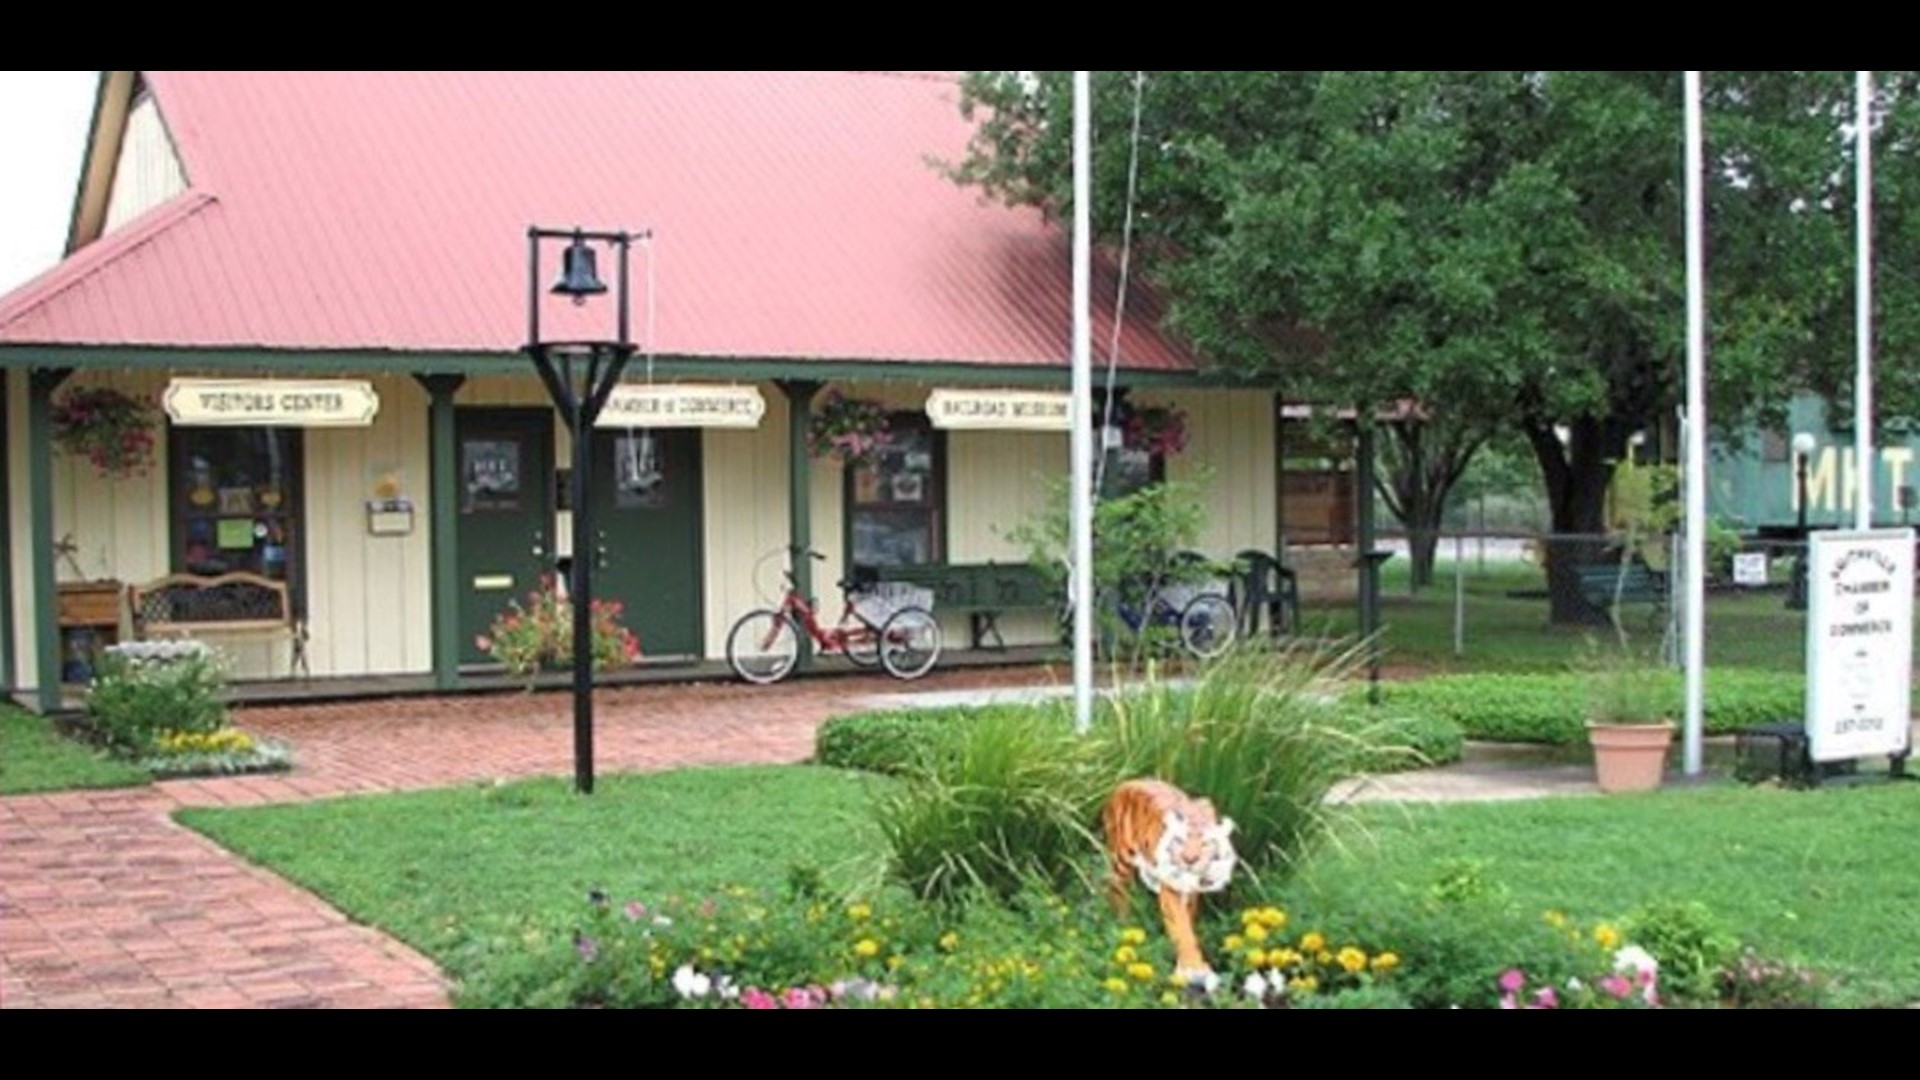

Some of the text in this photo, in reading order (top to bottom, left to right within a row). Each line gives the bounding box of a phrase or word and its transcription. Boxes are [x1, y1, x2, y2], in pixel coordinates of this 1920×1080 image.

[199, 392, 344, 412] VISITORS CENTER
[1011, 401, 1068, 417] MUSEUM
